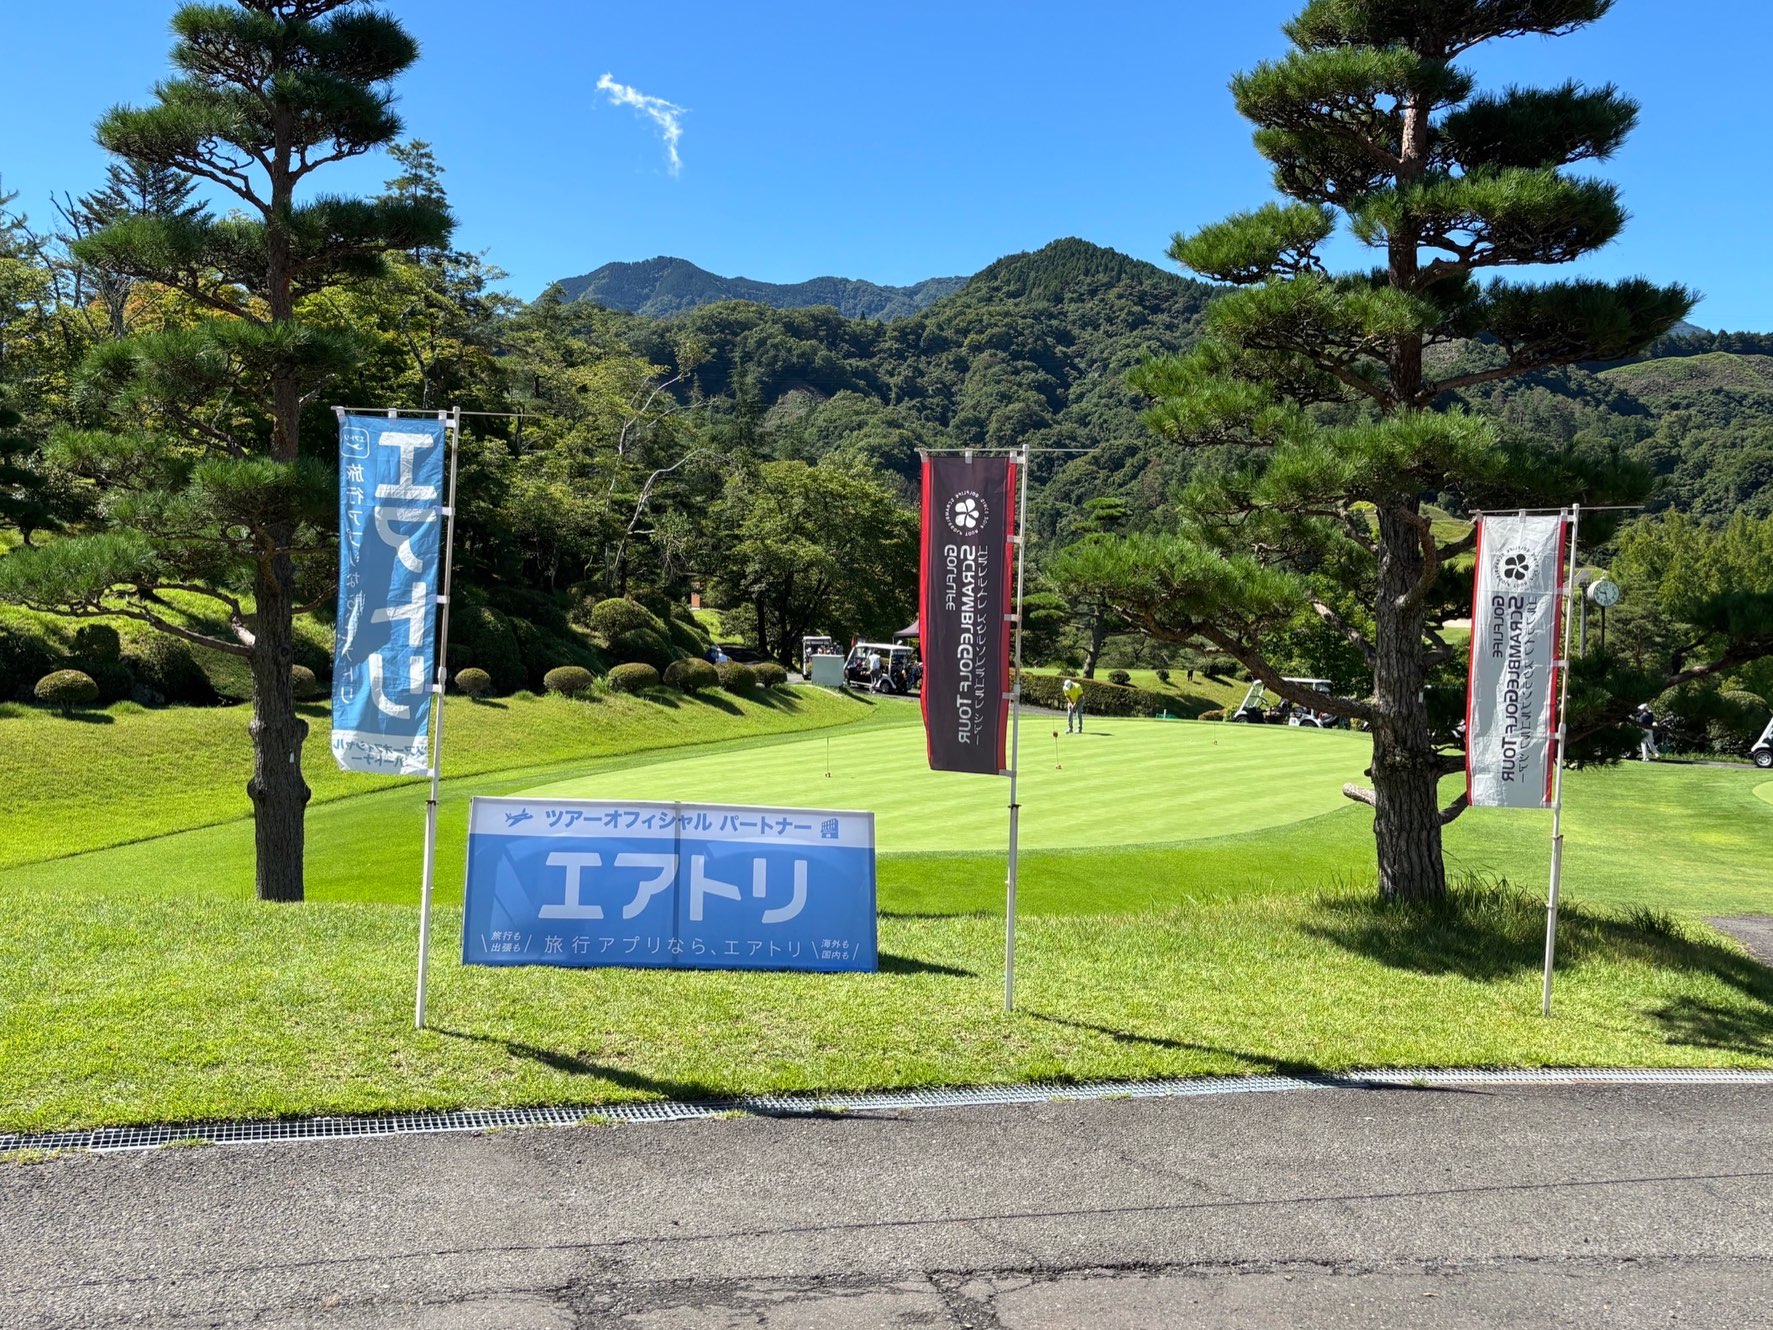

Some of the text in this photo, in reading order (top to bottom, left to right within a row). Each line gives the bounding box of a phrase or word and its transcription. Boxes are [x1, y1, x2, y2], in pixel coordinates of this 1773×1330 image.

[545, 809, 813, 836] ツアーオフィシャル パートナー
[538, 851, 808, 925] エアトリ
[490, 930, 521, 941] 旅行も
[490, 941, 521, 953] 出張も
[544, 934, 802, 958] 旅行アプリなら、エアトリ
[821, 938, 850, 949] 海外も
[821, 949, 850, 961] 国内も
